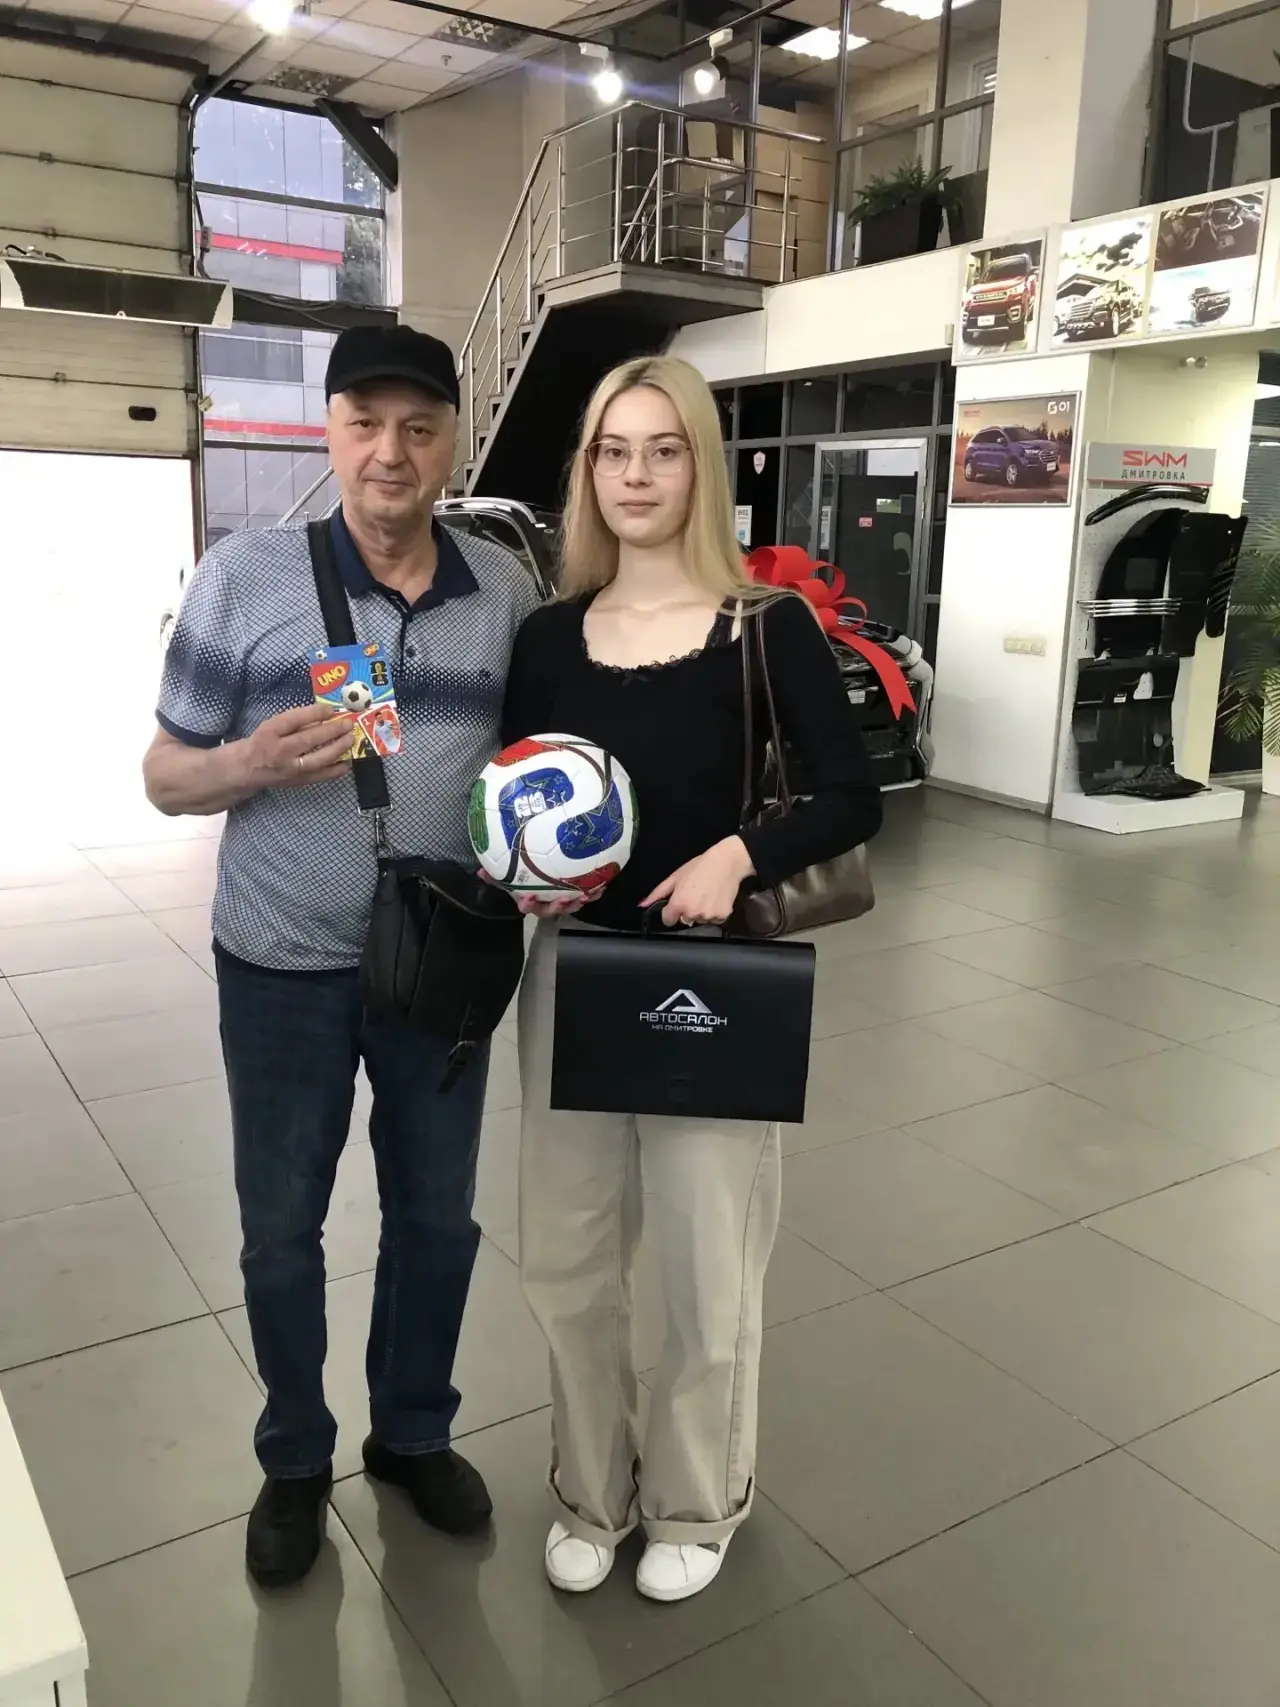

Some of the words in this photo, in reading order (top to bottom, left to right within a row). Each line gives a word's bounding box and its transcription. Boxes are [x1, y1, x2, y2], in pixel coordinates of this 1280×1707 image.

[1122, 450, 1188, 469] SWM
[1121, 469, 1185, 480] ДМИТРОВКА
[363, 643, 380, 656] UNO
[317, 665, 346, 687] UNO
[639, 1012, 728, 1026] АВТОСАЛОН
[665, 1025, 713, 1033] ДМИТРОВКЕ
